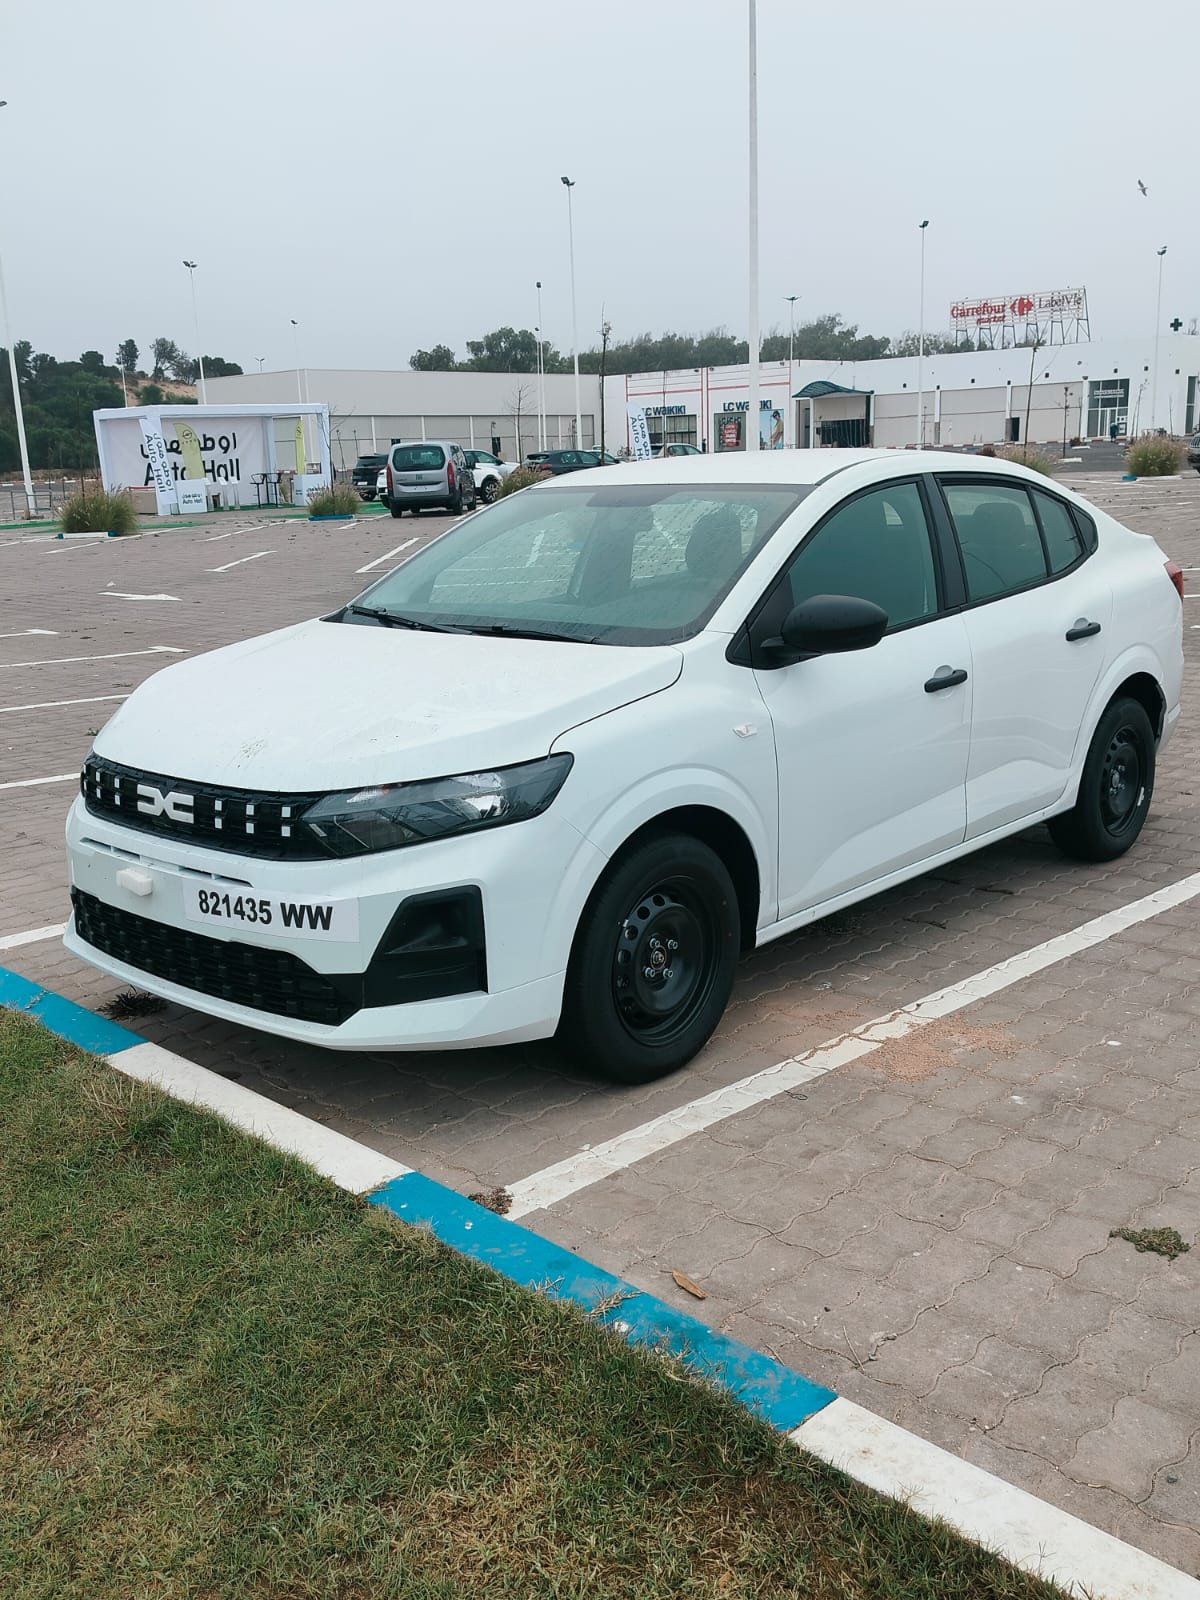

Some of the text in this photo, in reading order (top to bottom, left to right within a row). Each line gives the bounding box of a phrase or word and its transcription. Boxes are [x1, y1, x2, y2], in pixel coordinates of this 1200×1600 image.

[951, 303, 1006, 319] Carrefour
[723, 402, 734, 412] LC
[630, 416, 640, 444] Auto
[145, 434, 166, 493] Auto Hall
[202, 458, 240, 482] Hall
[198, 889, 333, 931] 821435 WW
